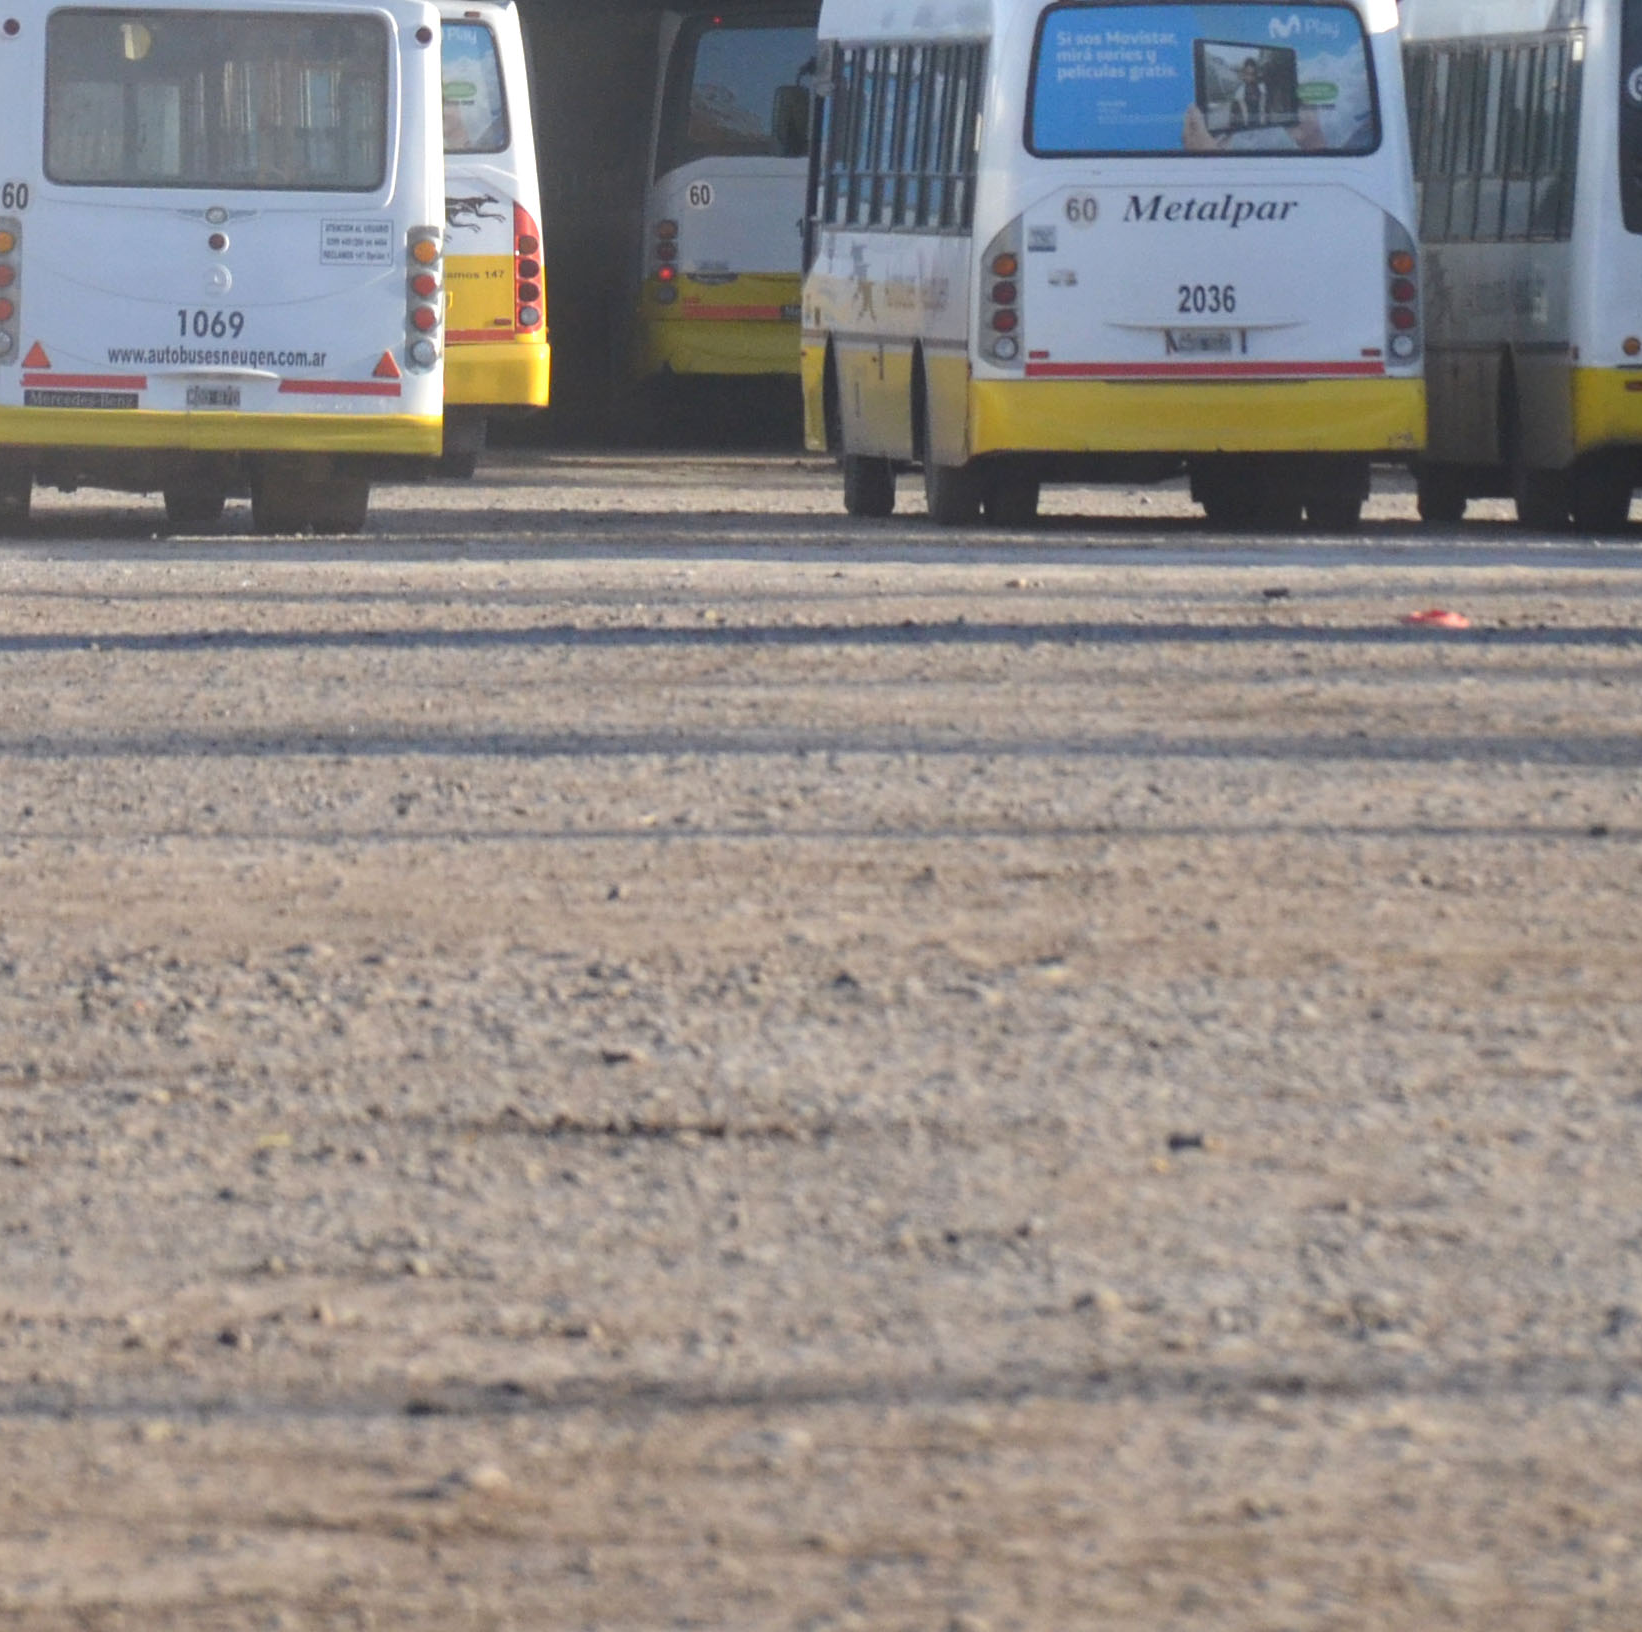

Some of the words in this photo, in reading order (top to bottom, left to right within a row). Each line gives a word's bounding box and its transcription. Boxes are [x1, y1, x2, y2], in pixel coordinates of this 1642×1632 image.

[2, 182, 29, 210] 60
[690, 185, 711, 206] 60
[1066, 197, 1098, 223] 60
[1122, 194, 1299, 228] Metalpar
[485, 270, 505, 279] 147
[1178, 285, 1236, 313] 2036
[177, 309, 245, 338] 1069
[108, 345, 328, 369] www.autobusesneuqen.com.ar
